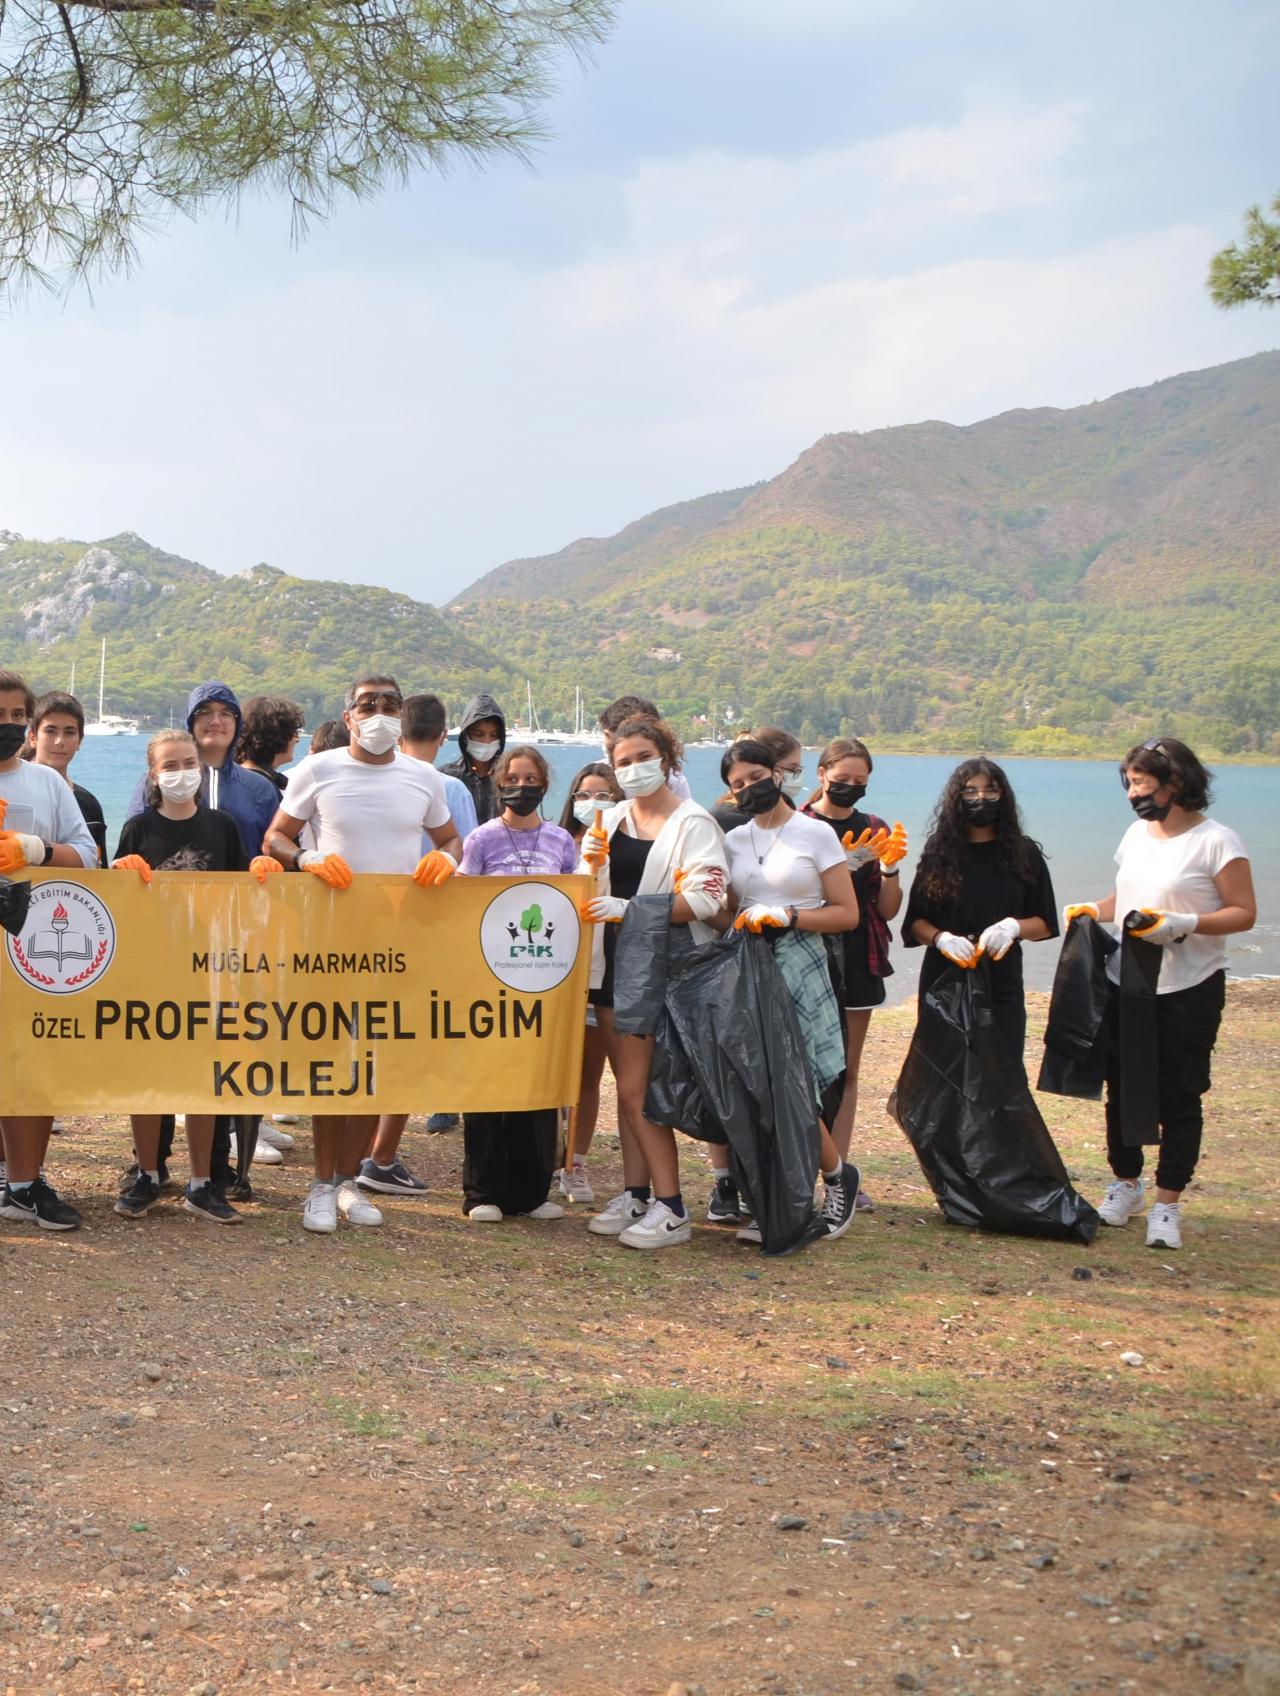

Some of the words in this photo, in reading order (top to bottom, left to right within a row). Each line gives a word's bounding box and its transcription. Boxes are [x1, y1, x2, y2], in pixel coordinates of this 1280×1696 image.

[72, 893, 106, 935] BAKANLIĞI
[193, 948, 271, 973] MUĞLA
[293, 948, 407, 973] MARMARİS
[32, 1012, 86, 1038] ÖZEL
[95, 1000, 416, 1040] PROFESYONEL
[430, 990, 542, 1039] İLGİM
[213, 1051, 374, 1096] KOLEJİ
